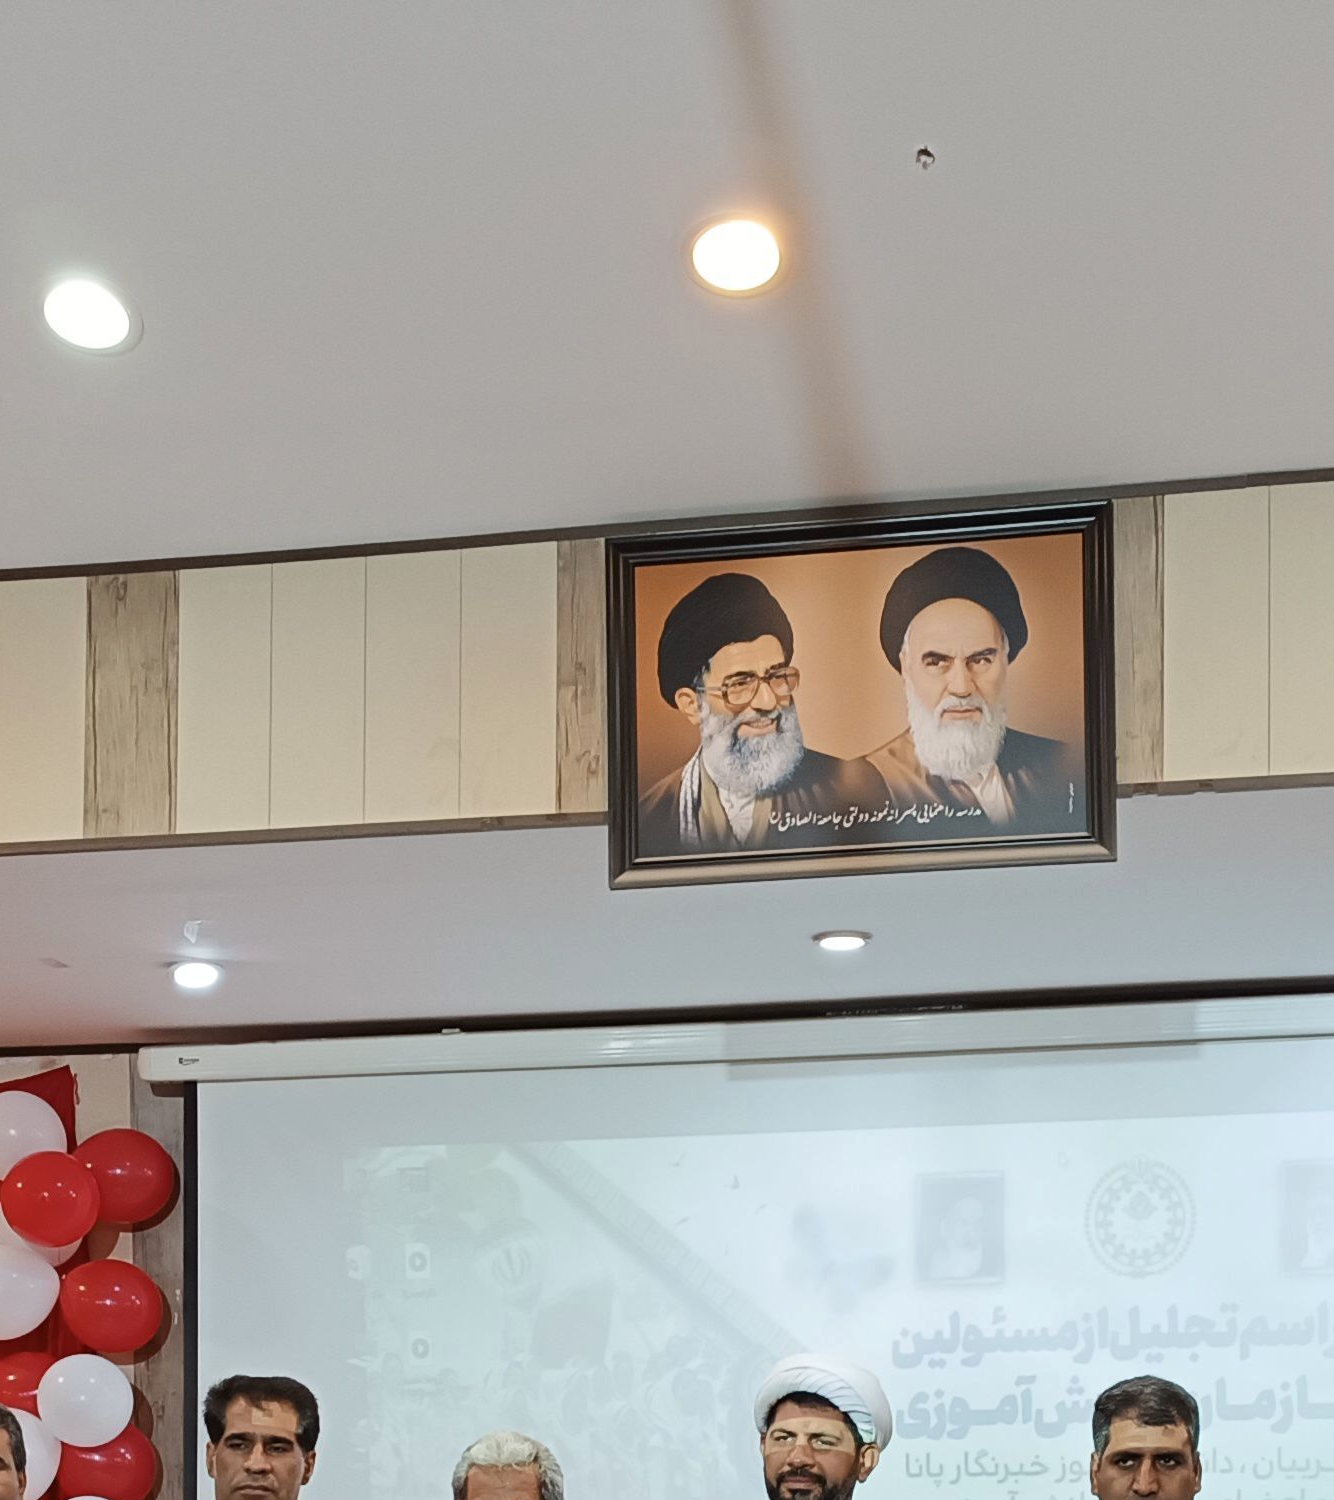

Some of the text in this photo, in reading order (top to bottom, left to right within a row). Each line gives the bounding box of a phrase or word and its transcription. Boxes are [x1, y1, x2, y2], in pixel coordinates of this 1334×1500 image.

[891, 1305, 1079, 1369] مسئولین
[1073, 1305, 1110, 1364] از
[1109, 1302, 1240, 1364] تجلیل
[896, 1374, 1037, 1441] آموزی
[905, 1451, 944, 1488] پانا
[948, 1448, 1050, 1485] خبرنگار
